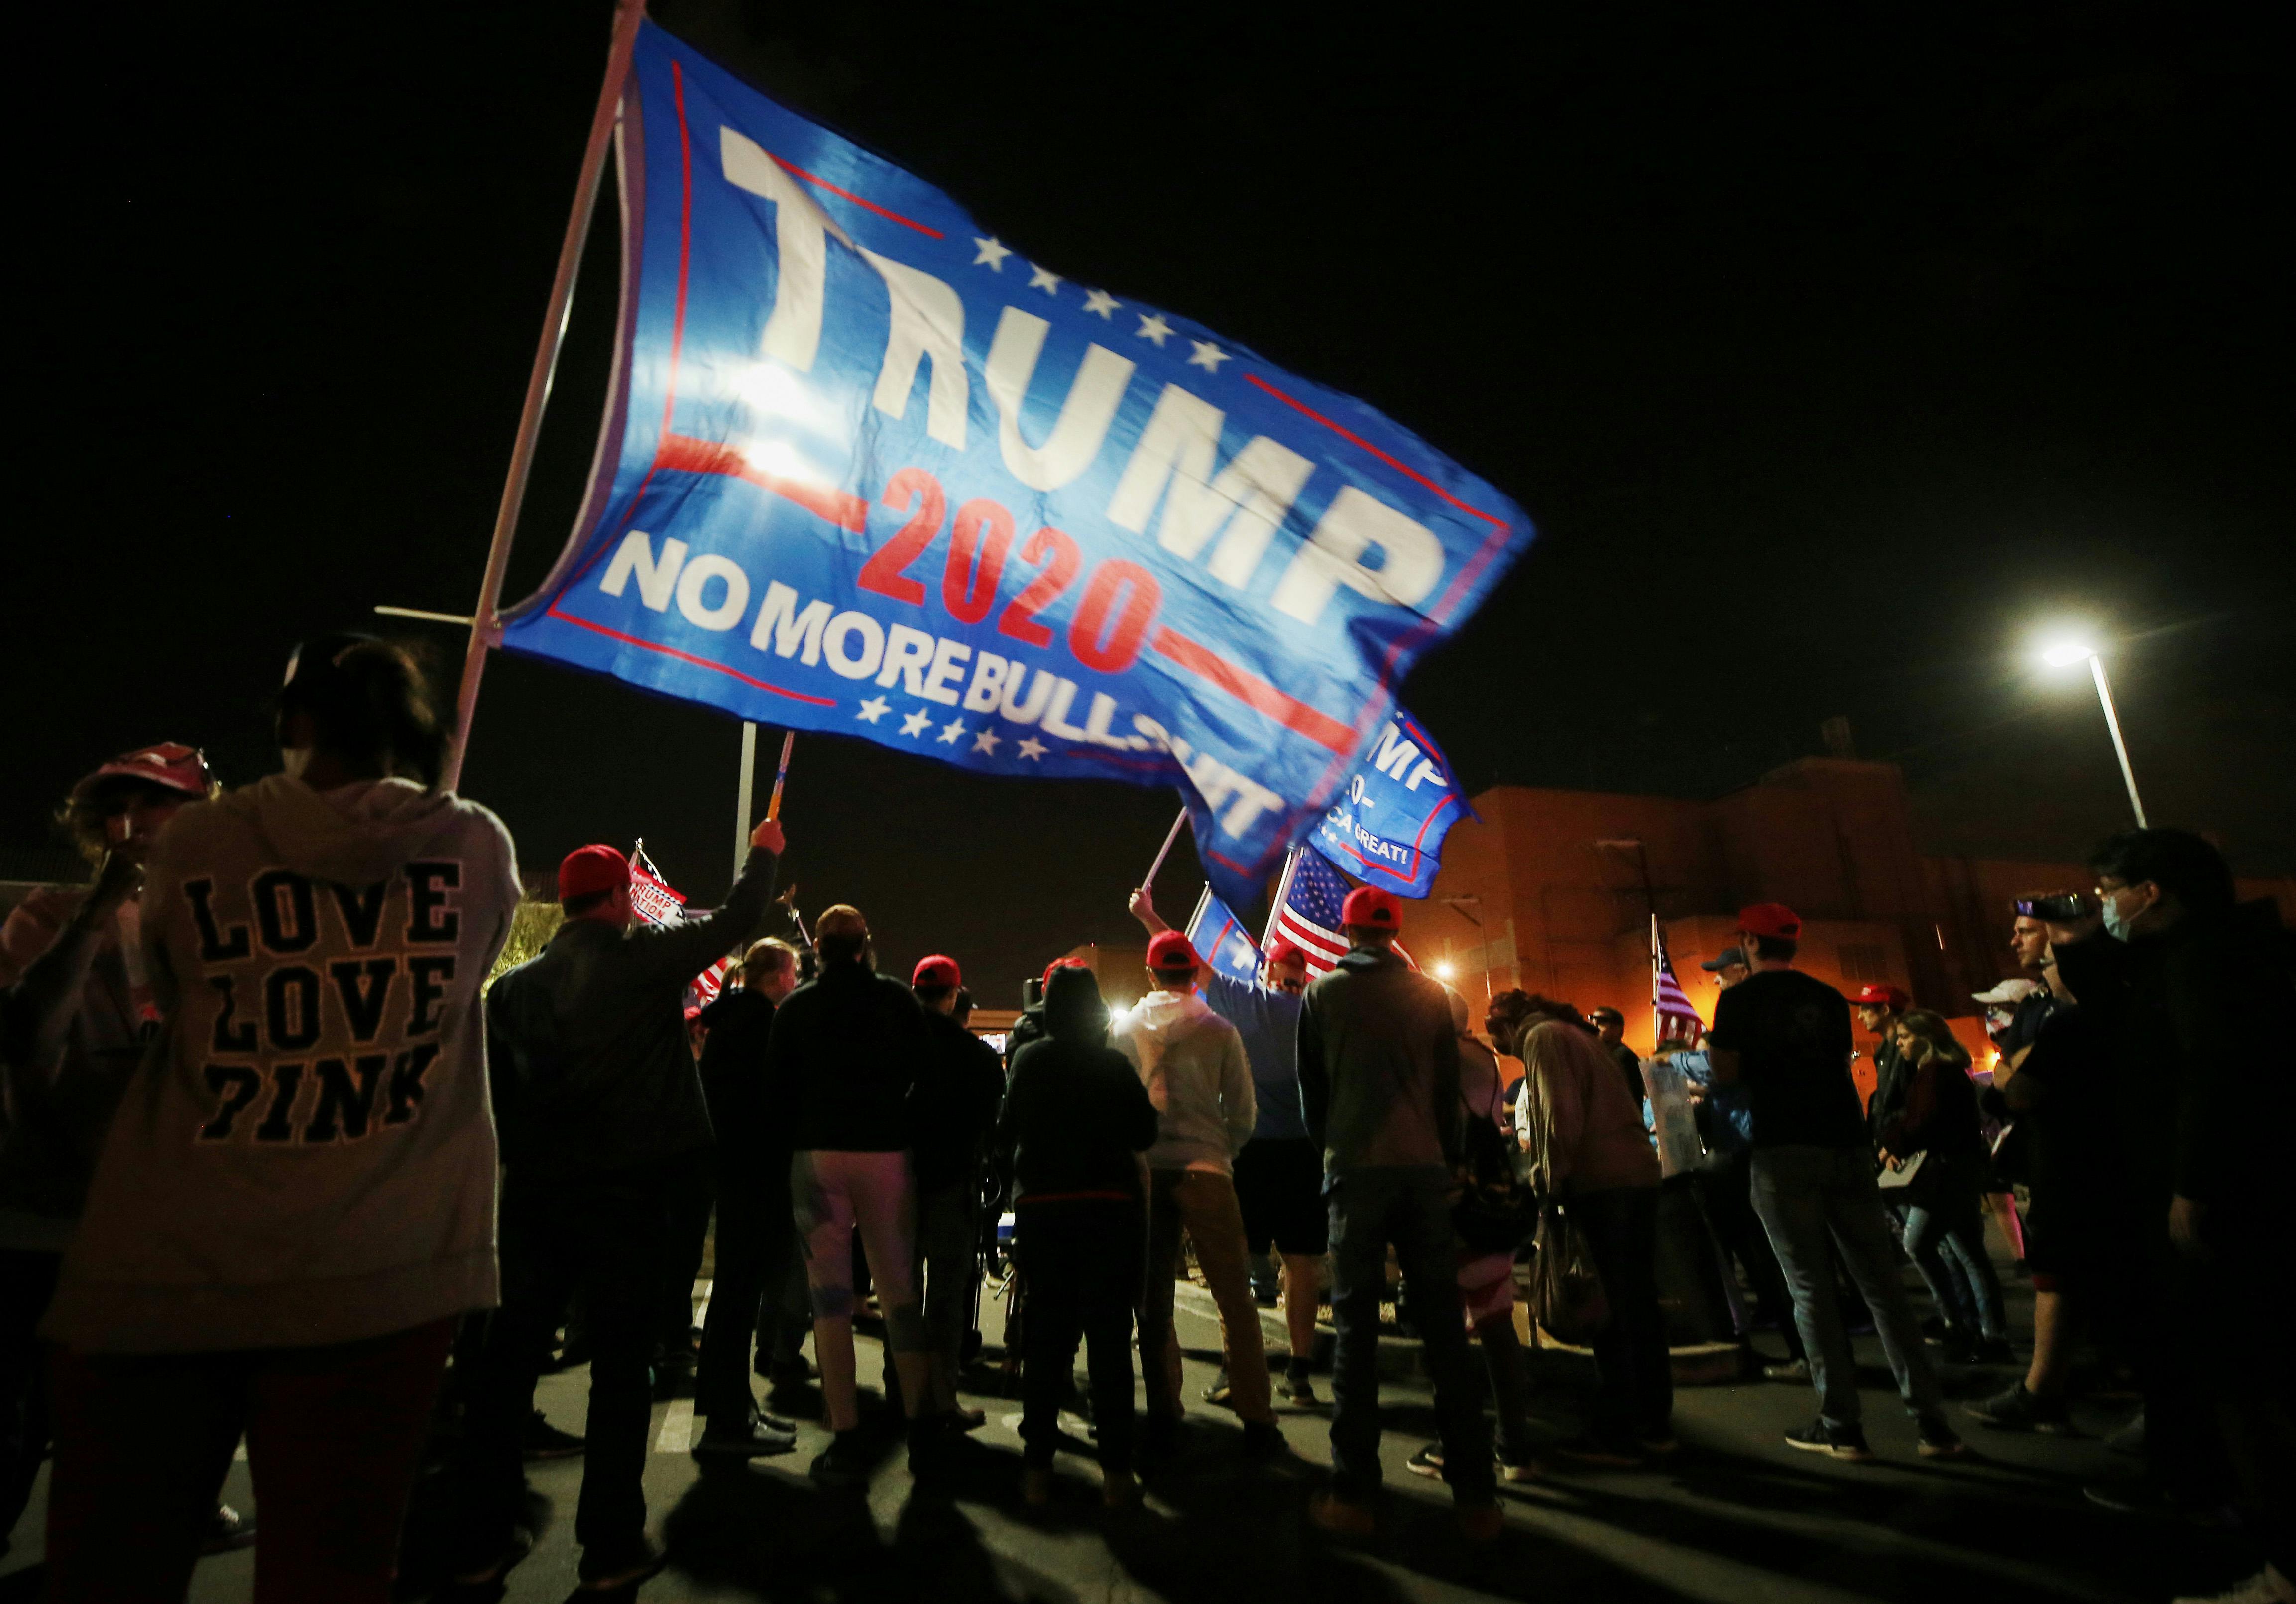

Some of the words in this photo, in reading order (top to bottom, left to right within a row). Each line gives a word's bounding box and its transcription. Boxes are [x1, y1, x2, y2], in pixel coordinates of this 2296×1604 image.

[720, 125, 1445, 625] TRUMP
[599, 530, 750, 631] NO
[750, 580, 971, 706] MORE
[857, 467, 1162, 674] 2020
[1354, 823, 1408, 864] GREAT!
[184, 861, 462, 962] LOVE
[208, 956, 457, 1054] LOVE
[199, 1042, 441, 1142] PINK
